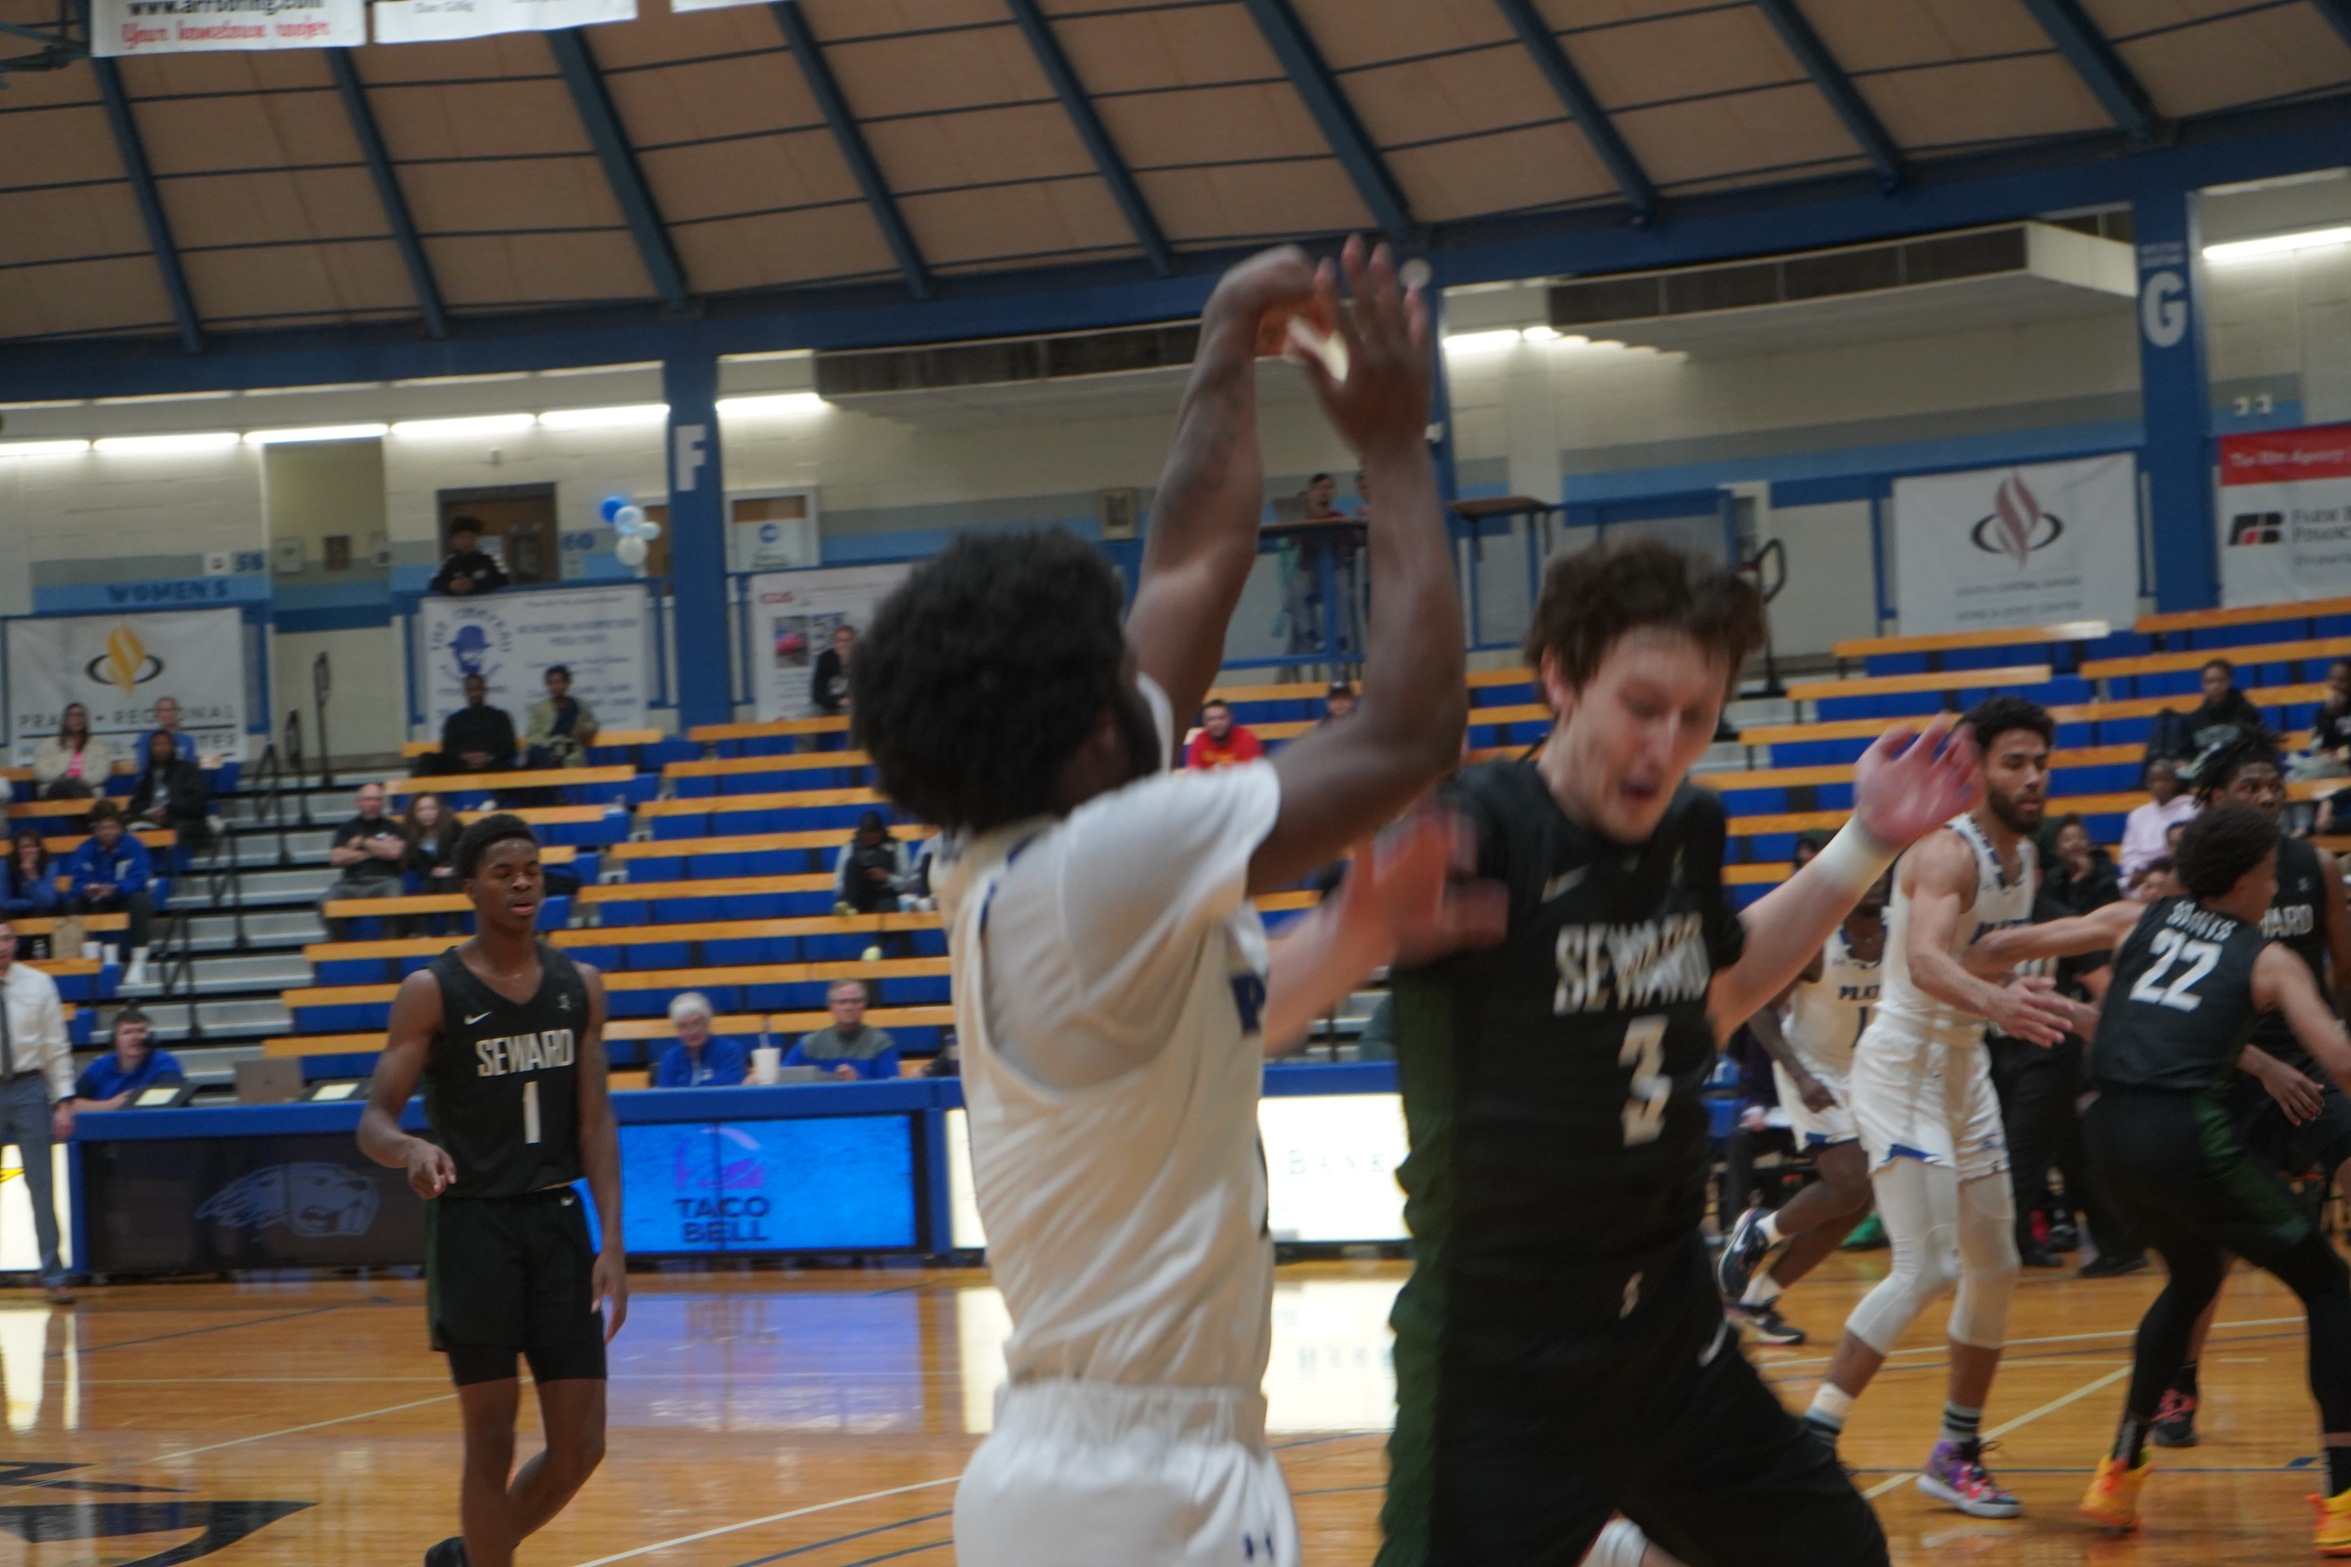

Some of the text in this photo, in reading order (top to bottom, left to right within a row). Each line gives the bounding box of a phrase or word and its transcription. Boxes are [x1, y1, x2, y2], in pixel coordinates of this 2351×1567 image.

[2143, 271, 2188, 348] G
[676, 424, 707, 492] F
[1553, 912, 1712, 1017] SEWARD
[2128, 927, 2223, 1013] 22
[475, 1028, 576, 1078] SEWARD
[1618, 1014, 1674, 1148] 3
[522, 1080, 542, 1145] 1
[673, 1195, 771, 1218] TACO
[683, 1220, 769, 1244] BELL
